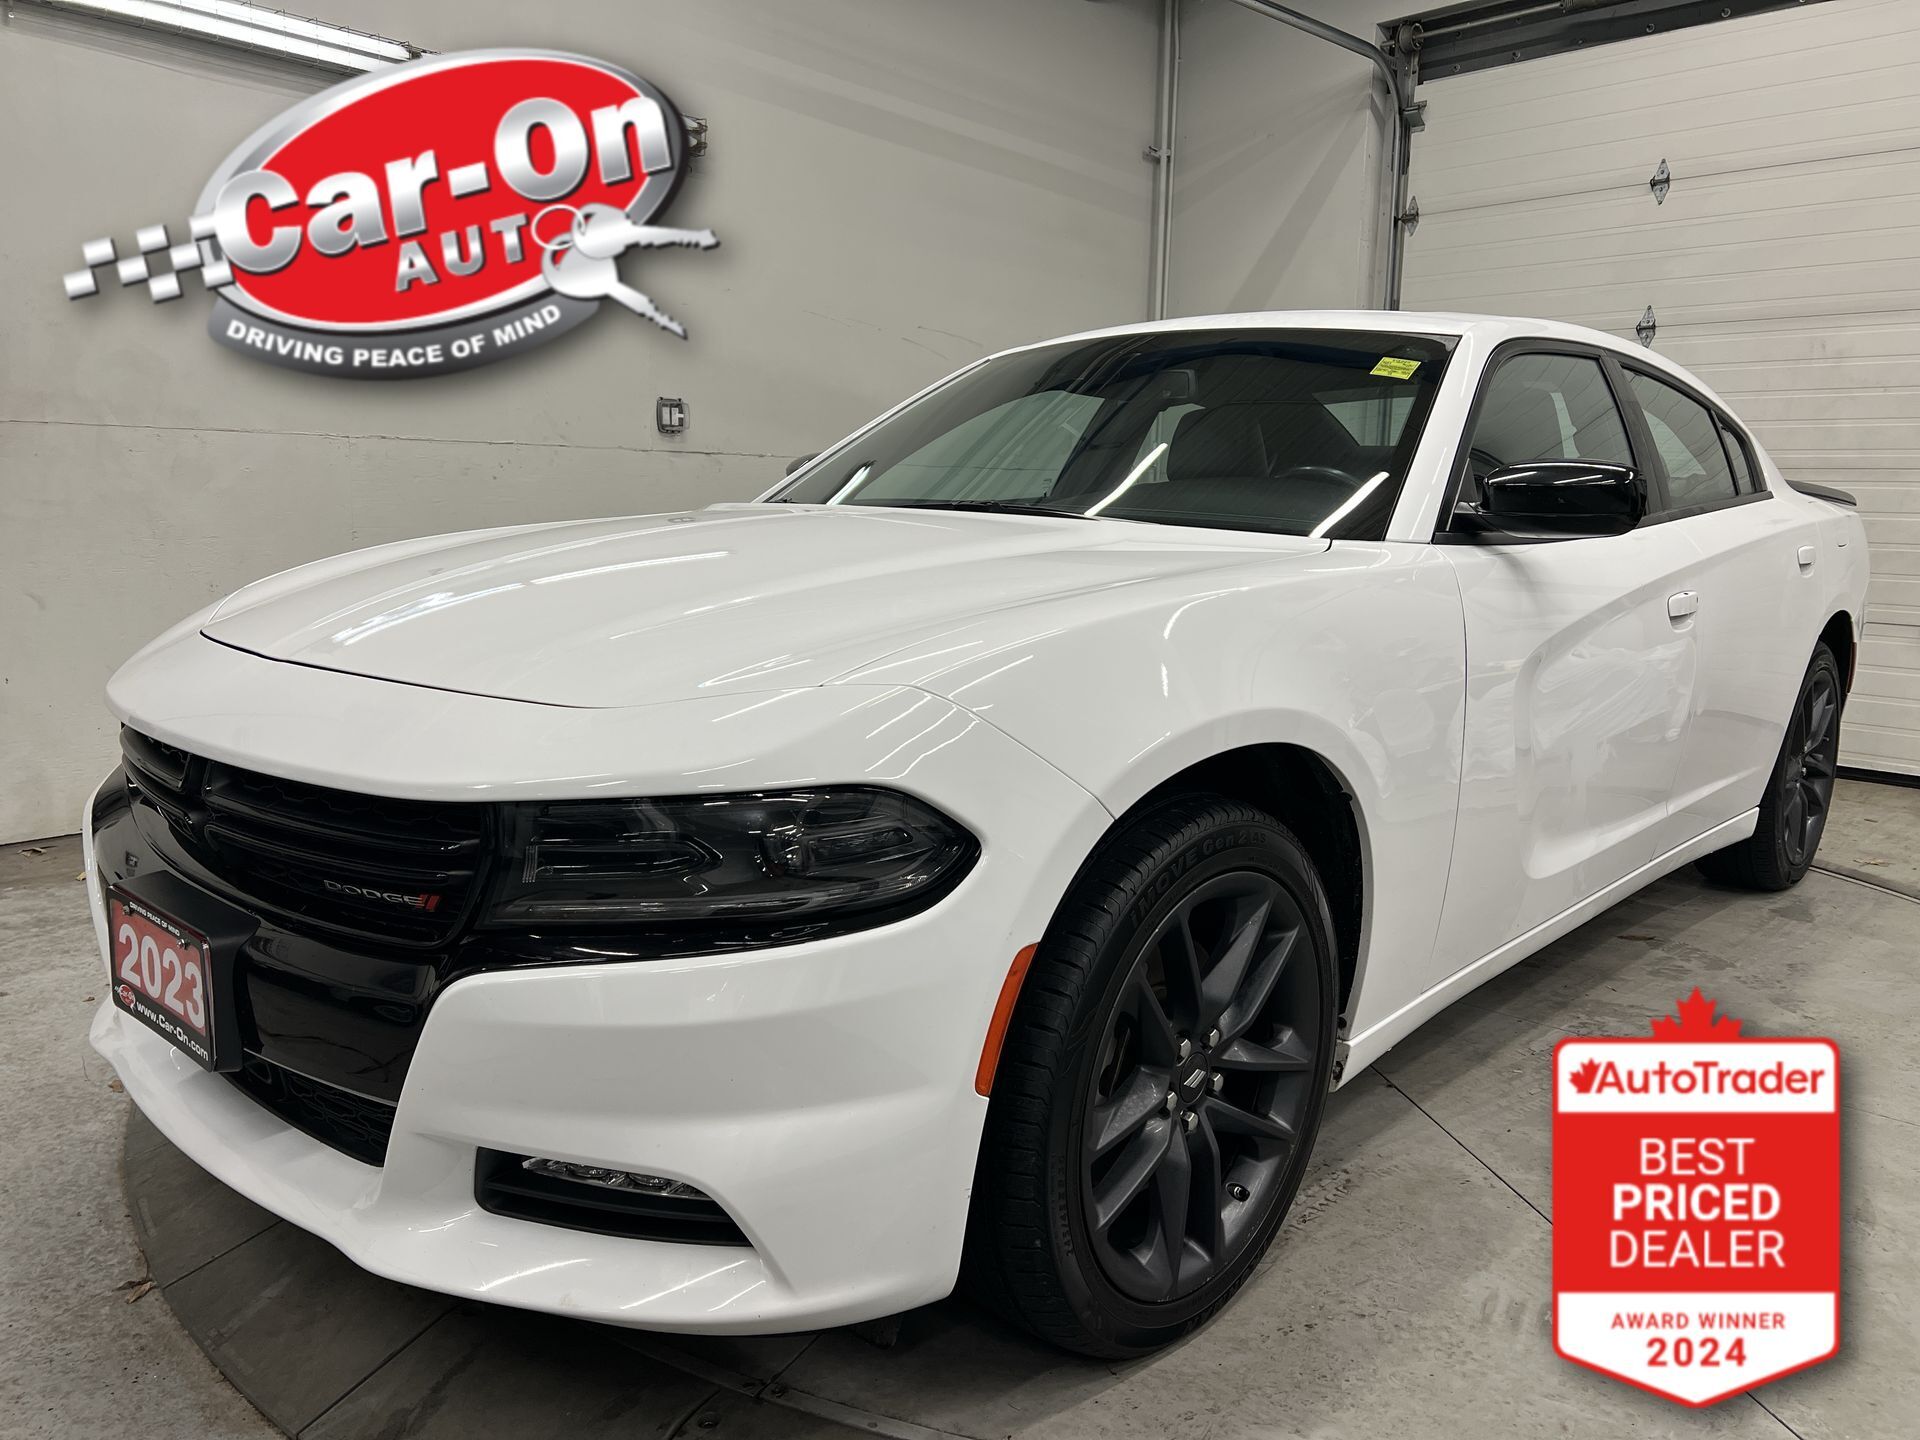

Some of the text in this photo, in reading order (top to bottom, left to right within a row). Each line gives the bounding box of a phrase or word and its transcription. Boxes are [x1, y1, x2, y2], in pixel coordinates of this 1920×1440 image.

[324, 880, 425, 907] DODGE
[119, 923, 205, 1029] 2023
[136, 1002, 209, 1061] www.Car-On.com
